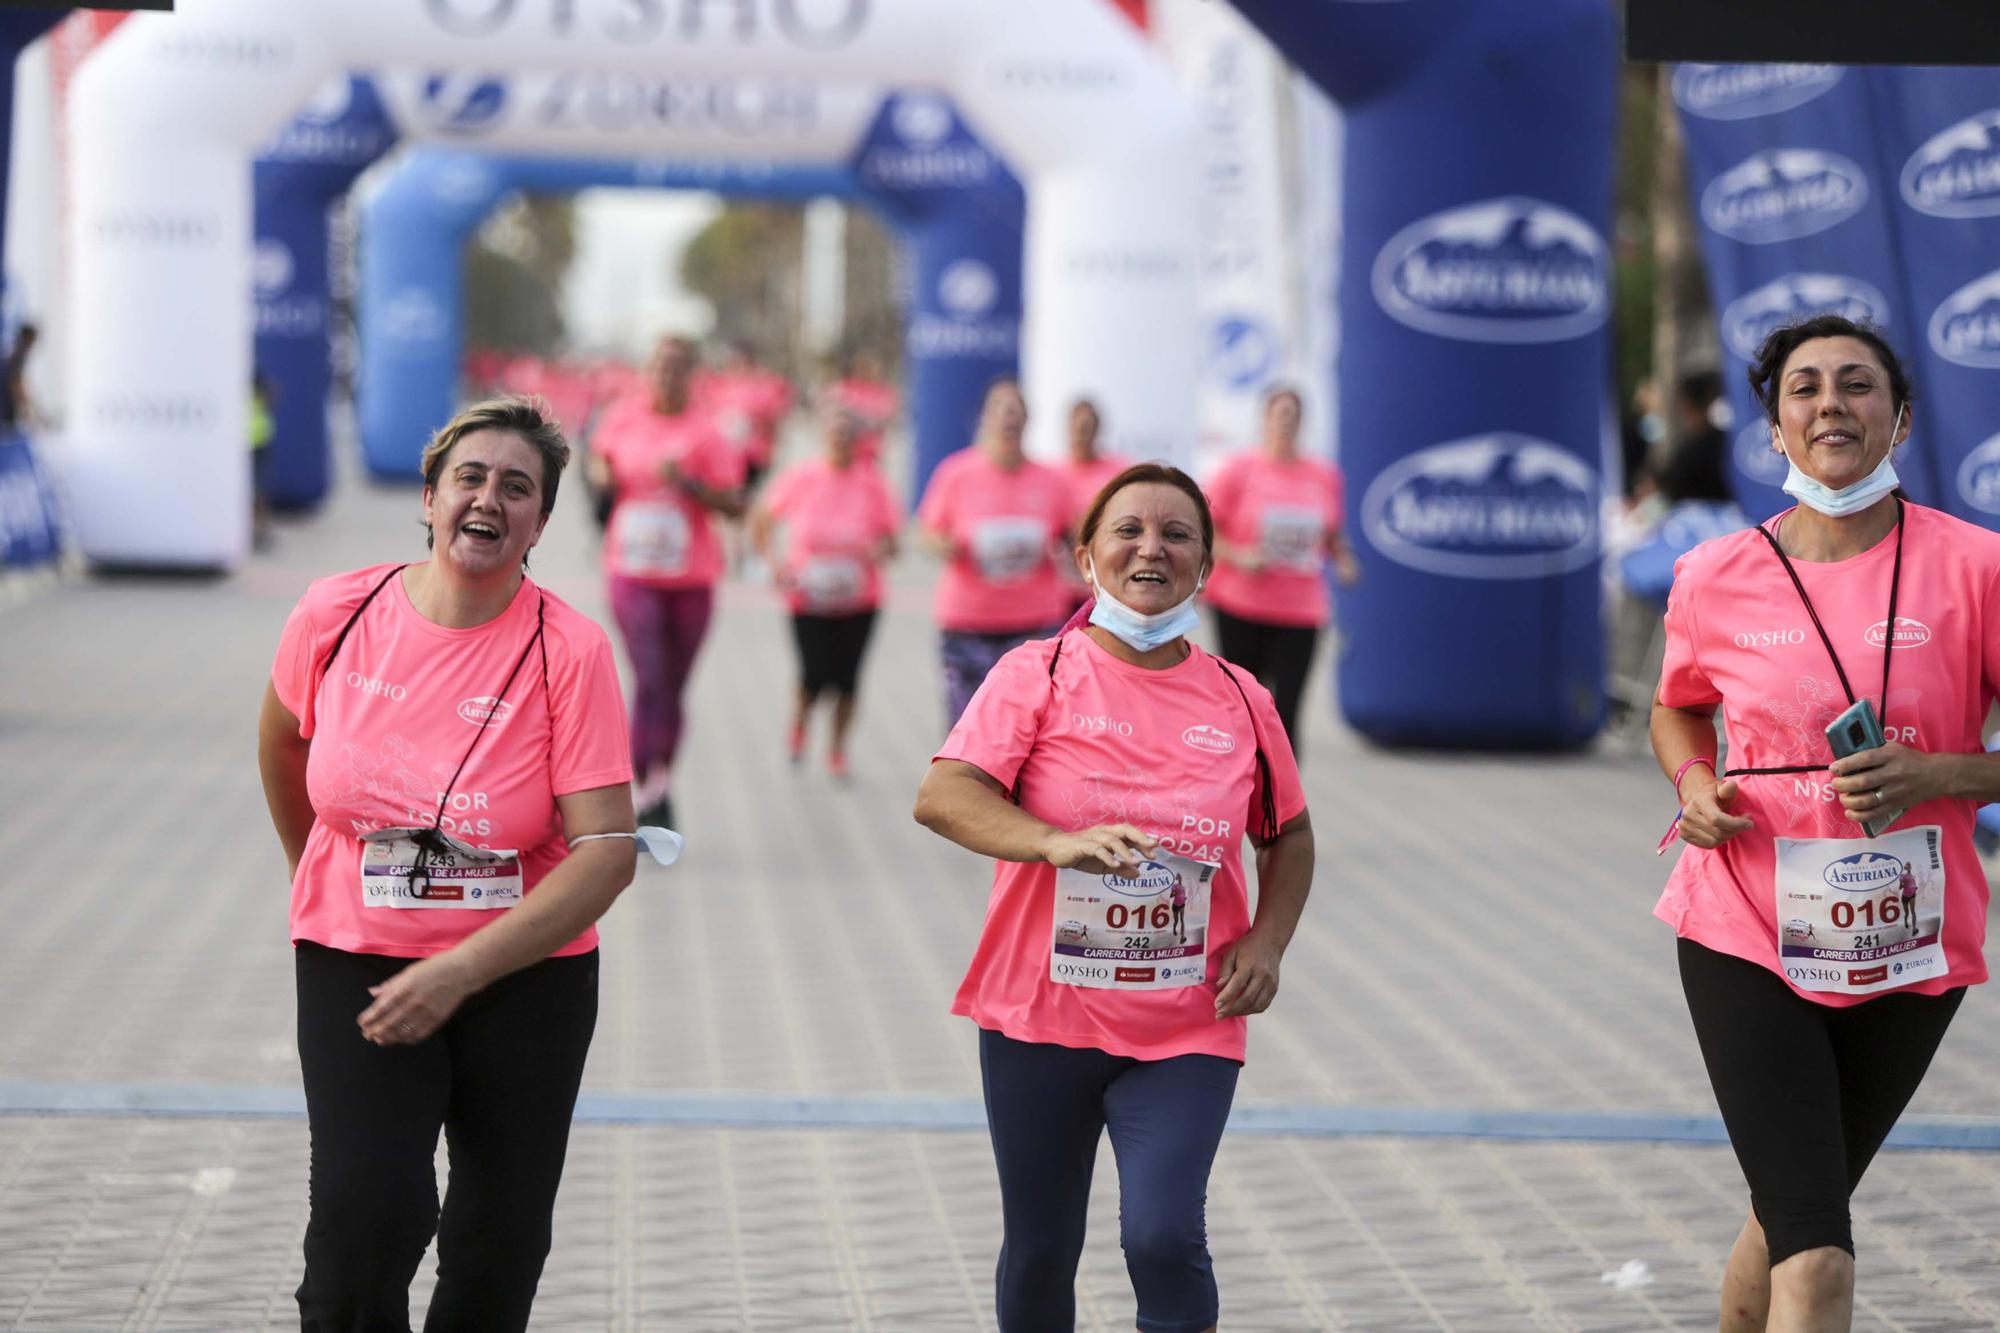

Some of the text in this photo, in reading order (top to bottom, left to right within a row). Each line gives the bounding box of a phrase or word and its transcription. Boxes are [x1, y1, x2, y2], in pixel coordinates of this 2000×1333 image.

[1734, 629, 1805, 649] OYSHO
[346, 671, 407, 702] OYSHO
[1883, 726, 1917, 743] OR
[437, 791, 489, 811] POR
[1181, 815, 1230, 838] POR
[430, 854, 456, 867] 243
[435, 867, 448, 877] DE
[450, 867, 463, 877] LA
[464, 867, 496, 877] MUJER
[1829, 866, 1898, 883] ASTURIANA
[1108, 873, 1170, 888] ASTURIANA
[1106, 904, 1170, 929] 016
[1831, 896, 1900, 928] 016
[1124, 936, 1150, 949] 242
[1854, 934, 1880, 949] 241
[1084, 948, 1185, 960] CARRERA DE LA MUJER
[1813, 941, 1917, 961] CARRERA DE LA MUJER
[1905, 957, 1933, 970] ZURICH
[1057, 964, 1108, 980] OYSHO
[1787, 967, 1841, 981] OYSHO
